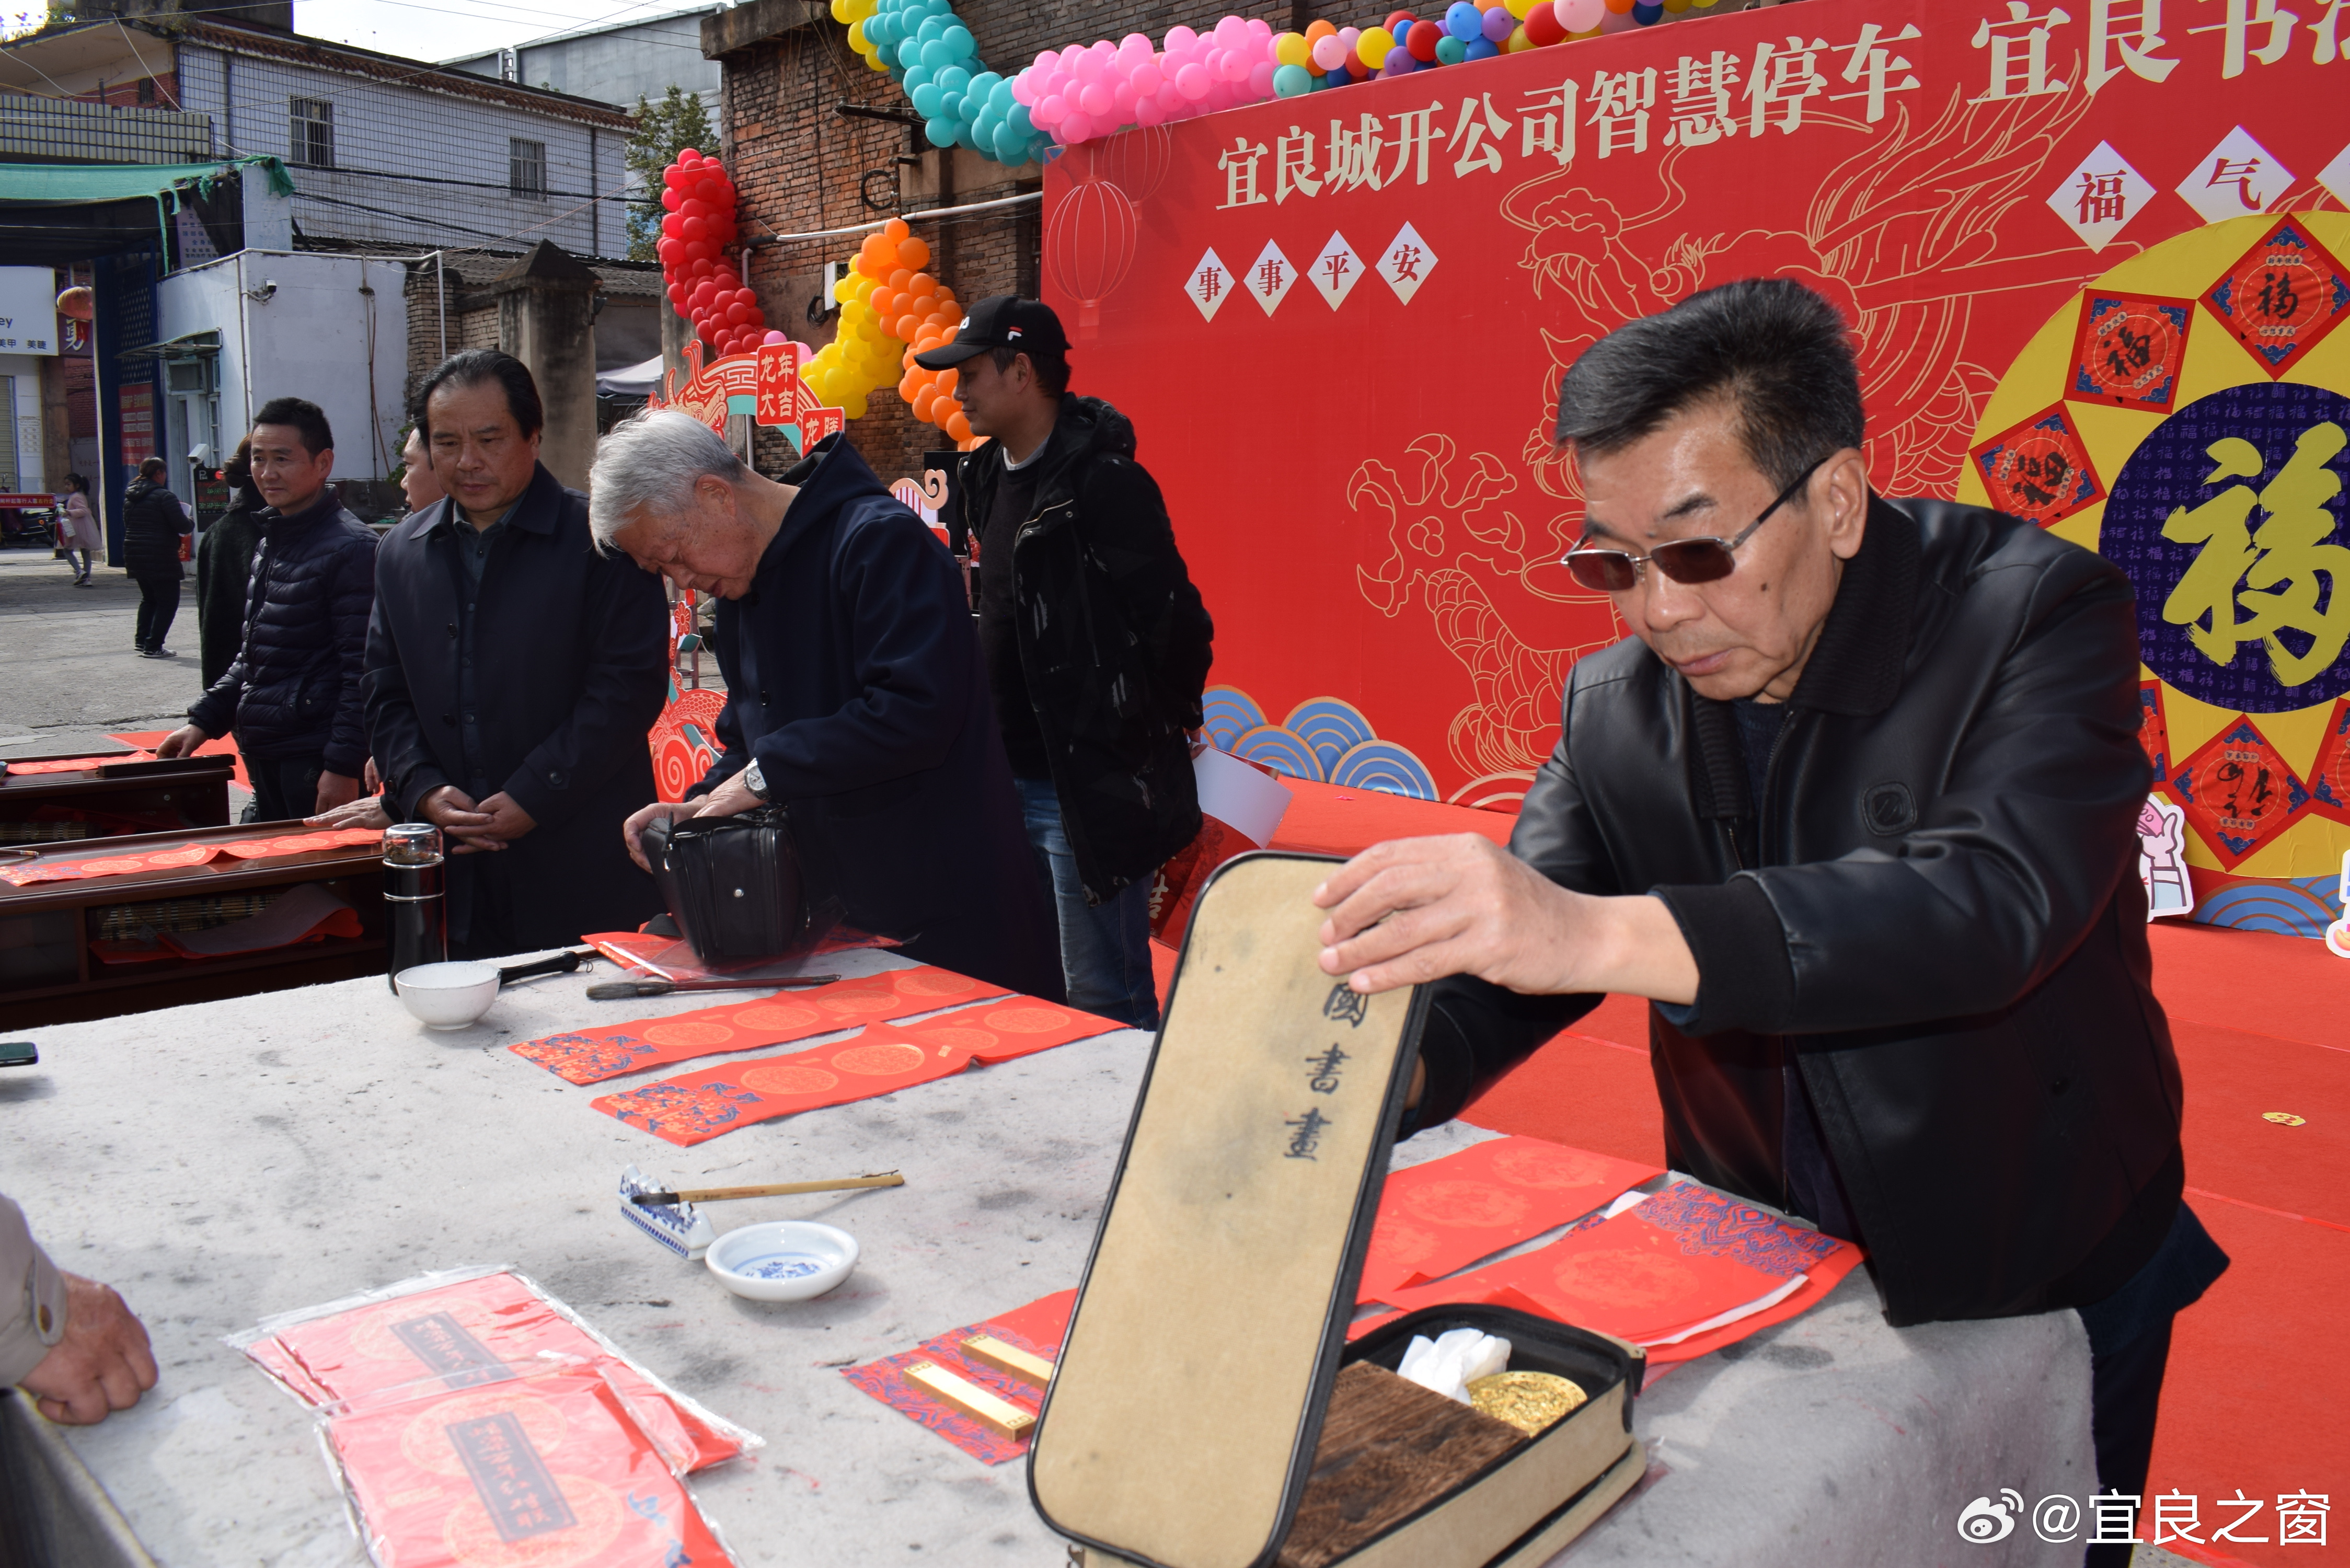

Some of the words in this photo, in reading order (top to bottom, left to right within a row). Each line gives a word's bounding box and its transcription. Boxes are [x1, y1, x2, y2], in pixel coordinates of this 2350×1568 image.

[1215, 22, 1922, 211] 宜良城开公司智慧停车
[1197, 244, 1422, 303] 事事平安
[759, 351, 795, 383] 龙年
[759, 386, 794, 418] 大吉
